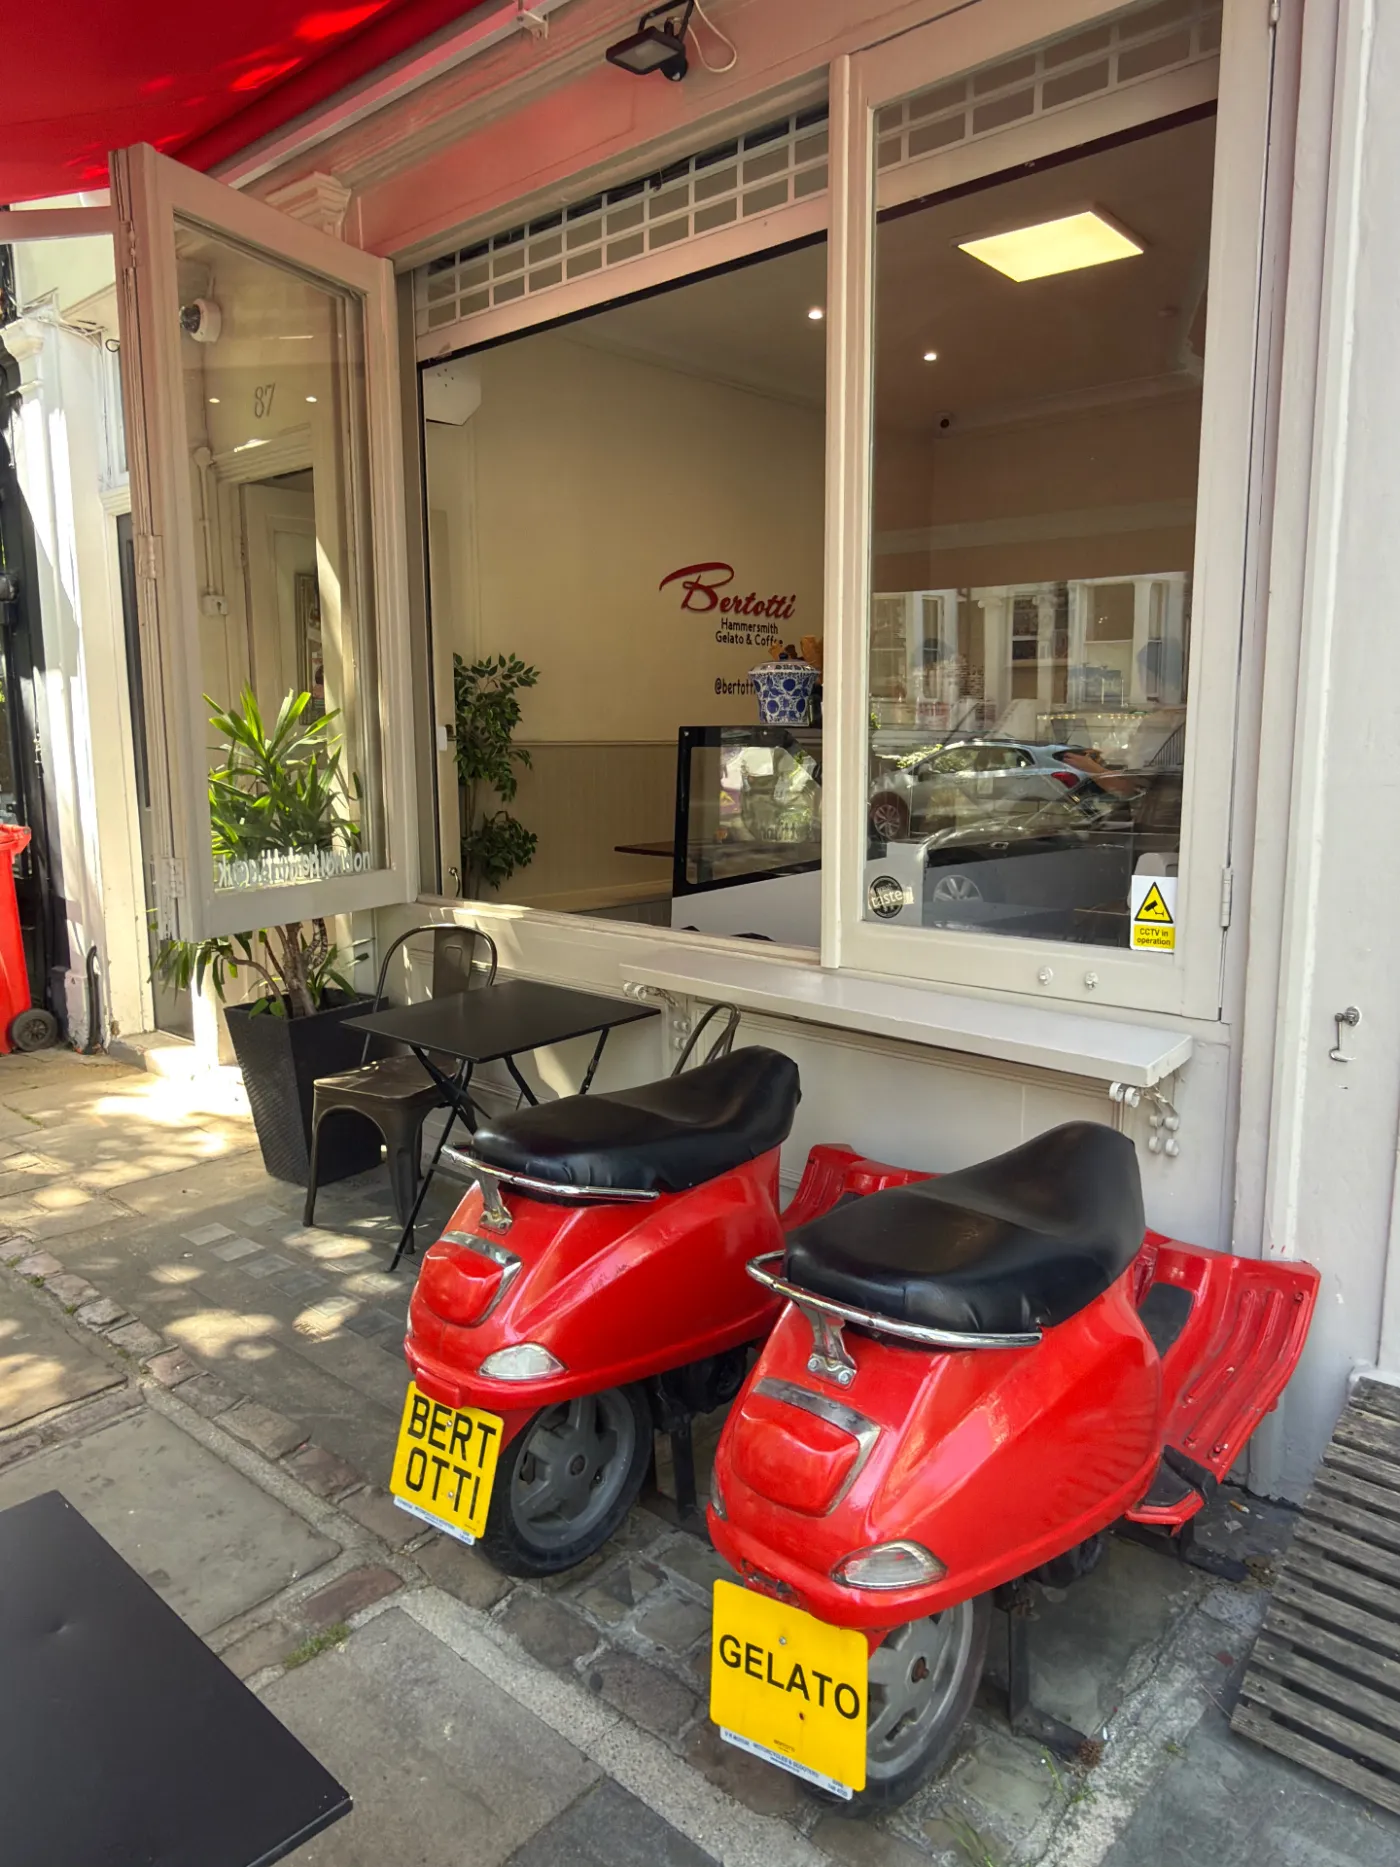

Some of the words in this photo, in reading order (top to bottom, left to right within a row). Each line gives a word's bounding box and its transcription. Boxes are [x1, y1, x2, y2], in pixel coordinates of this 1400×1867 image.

[254, 382, 276, 419] 87
[658, 561, 796, 619] Bertotti
[715, 630, 744, 645] Gelato
[746, 633, 753, 646] &
[754, 633, 783, 648] Coffe
[720, 617, 779, 635] Hammersmith
[1136, 937, 1171, 947] operation
[1139, 927, 1160, 937] CCTV
[1161, 930, 1169, 938] in
[408, 1394, 497, 1469] BERT
[405, 1446, 481, 1521] OTTI
[719, 1634, 860, 1720] GELATO
